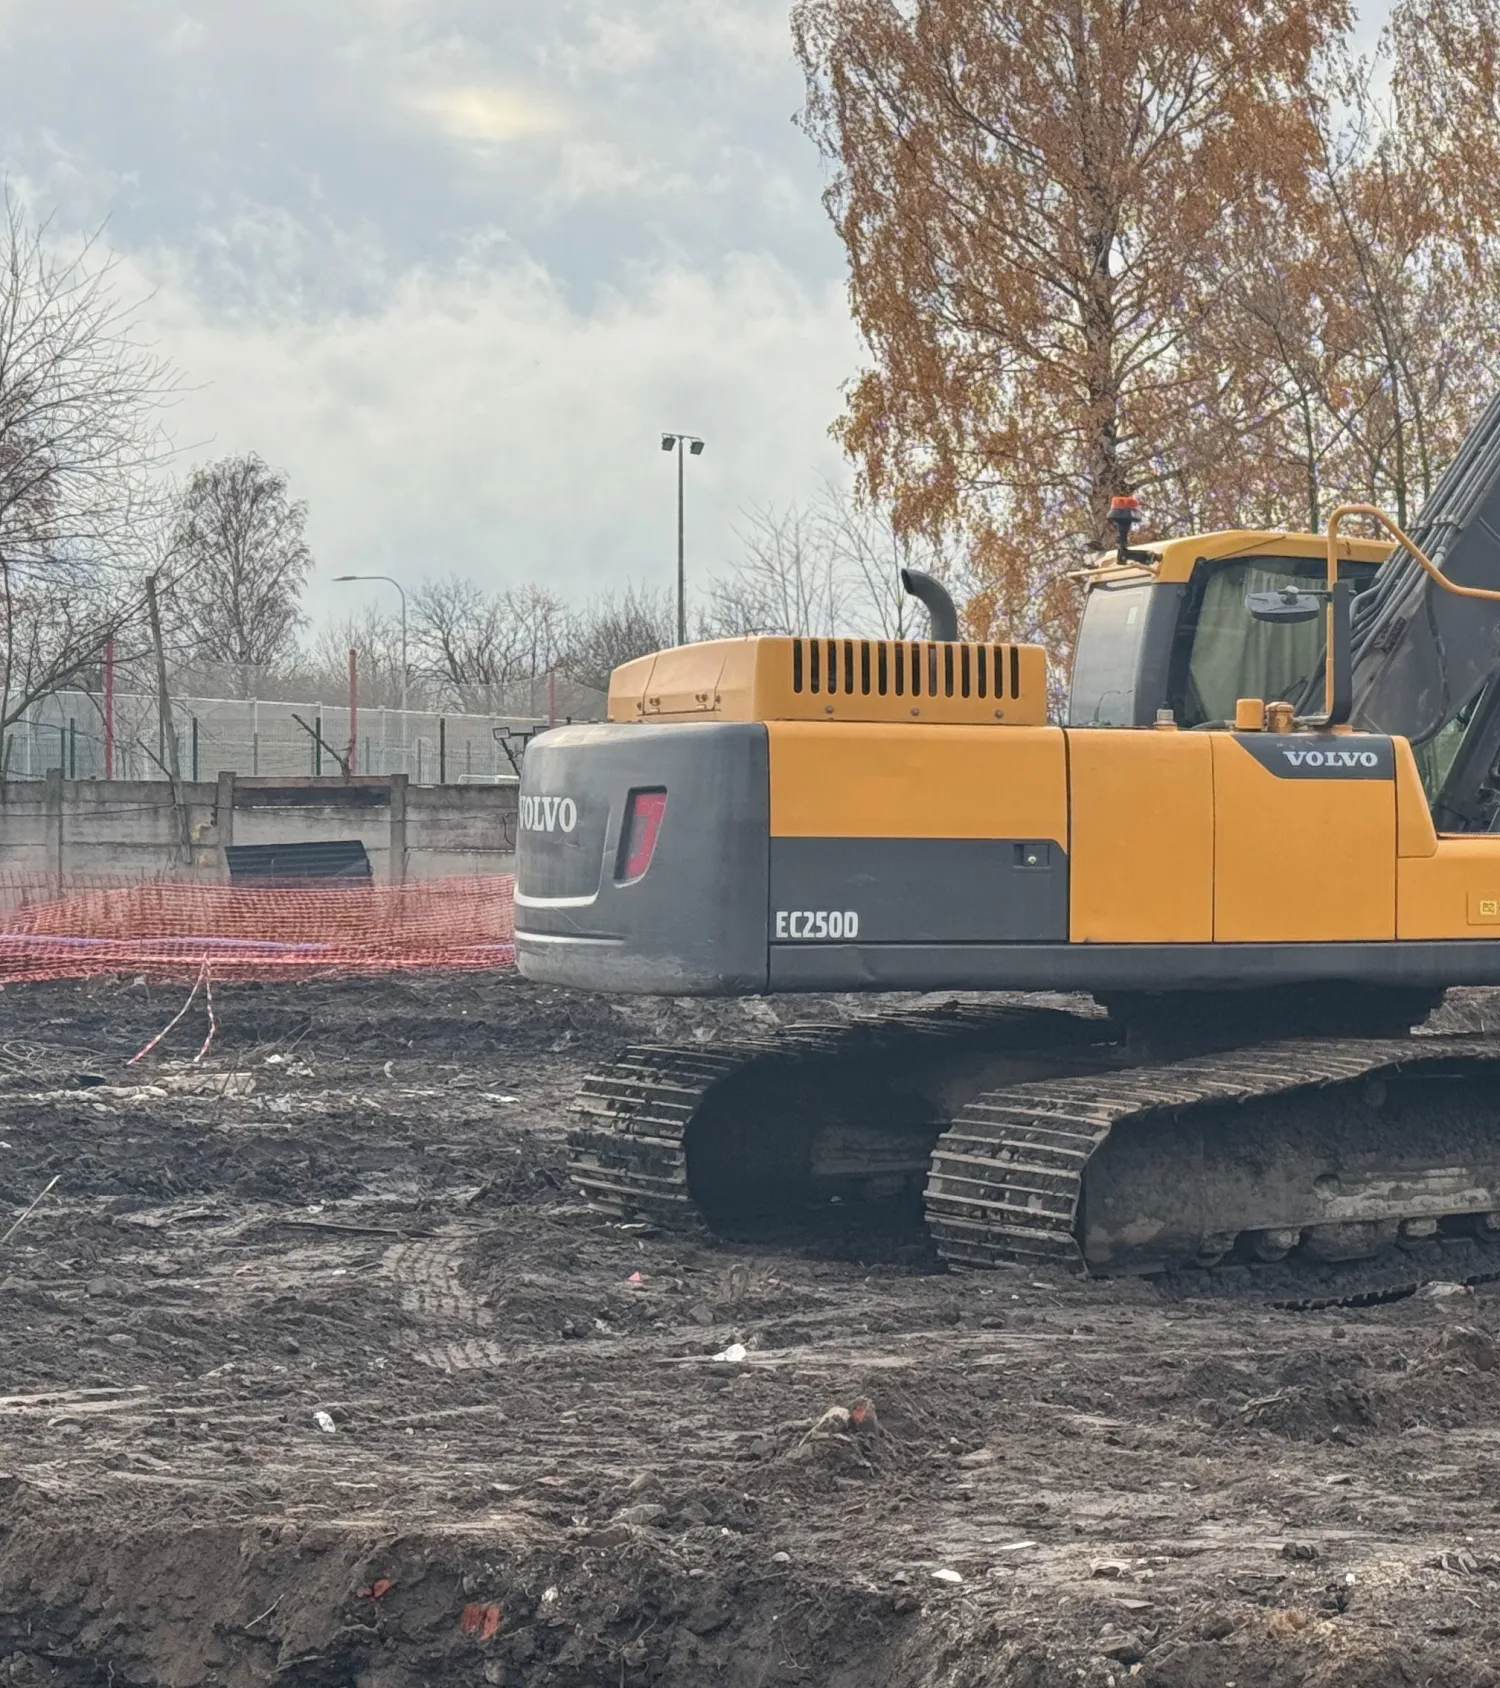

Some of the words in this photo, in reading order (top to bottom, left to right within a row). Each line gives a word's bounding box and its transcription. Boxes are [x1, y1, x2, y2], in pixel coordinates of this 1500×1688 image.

[1283, 751, 1378, 767] VOLVO
[519, 795, 577, 833] VOLVO
[776, 911, 859, 938] EC250D
